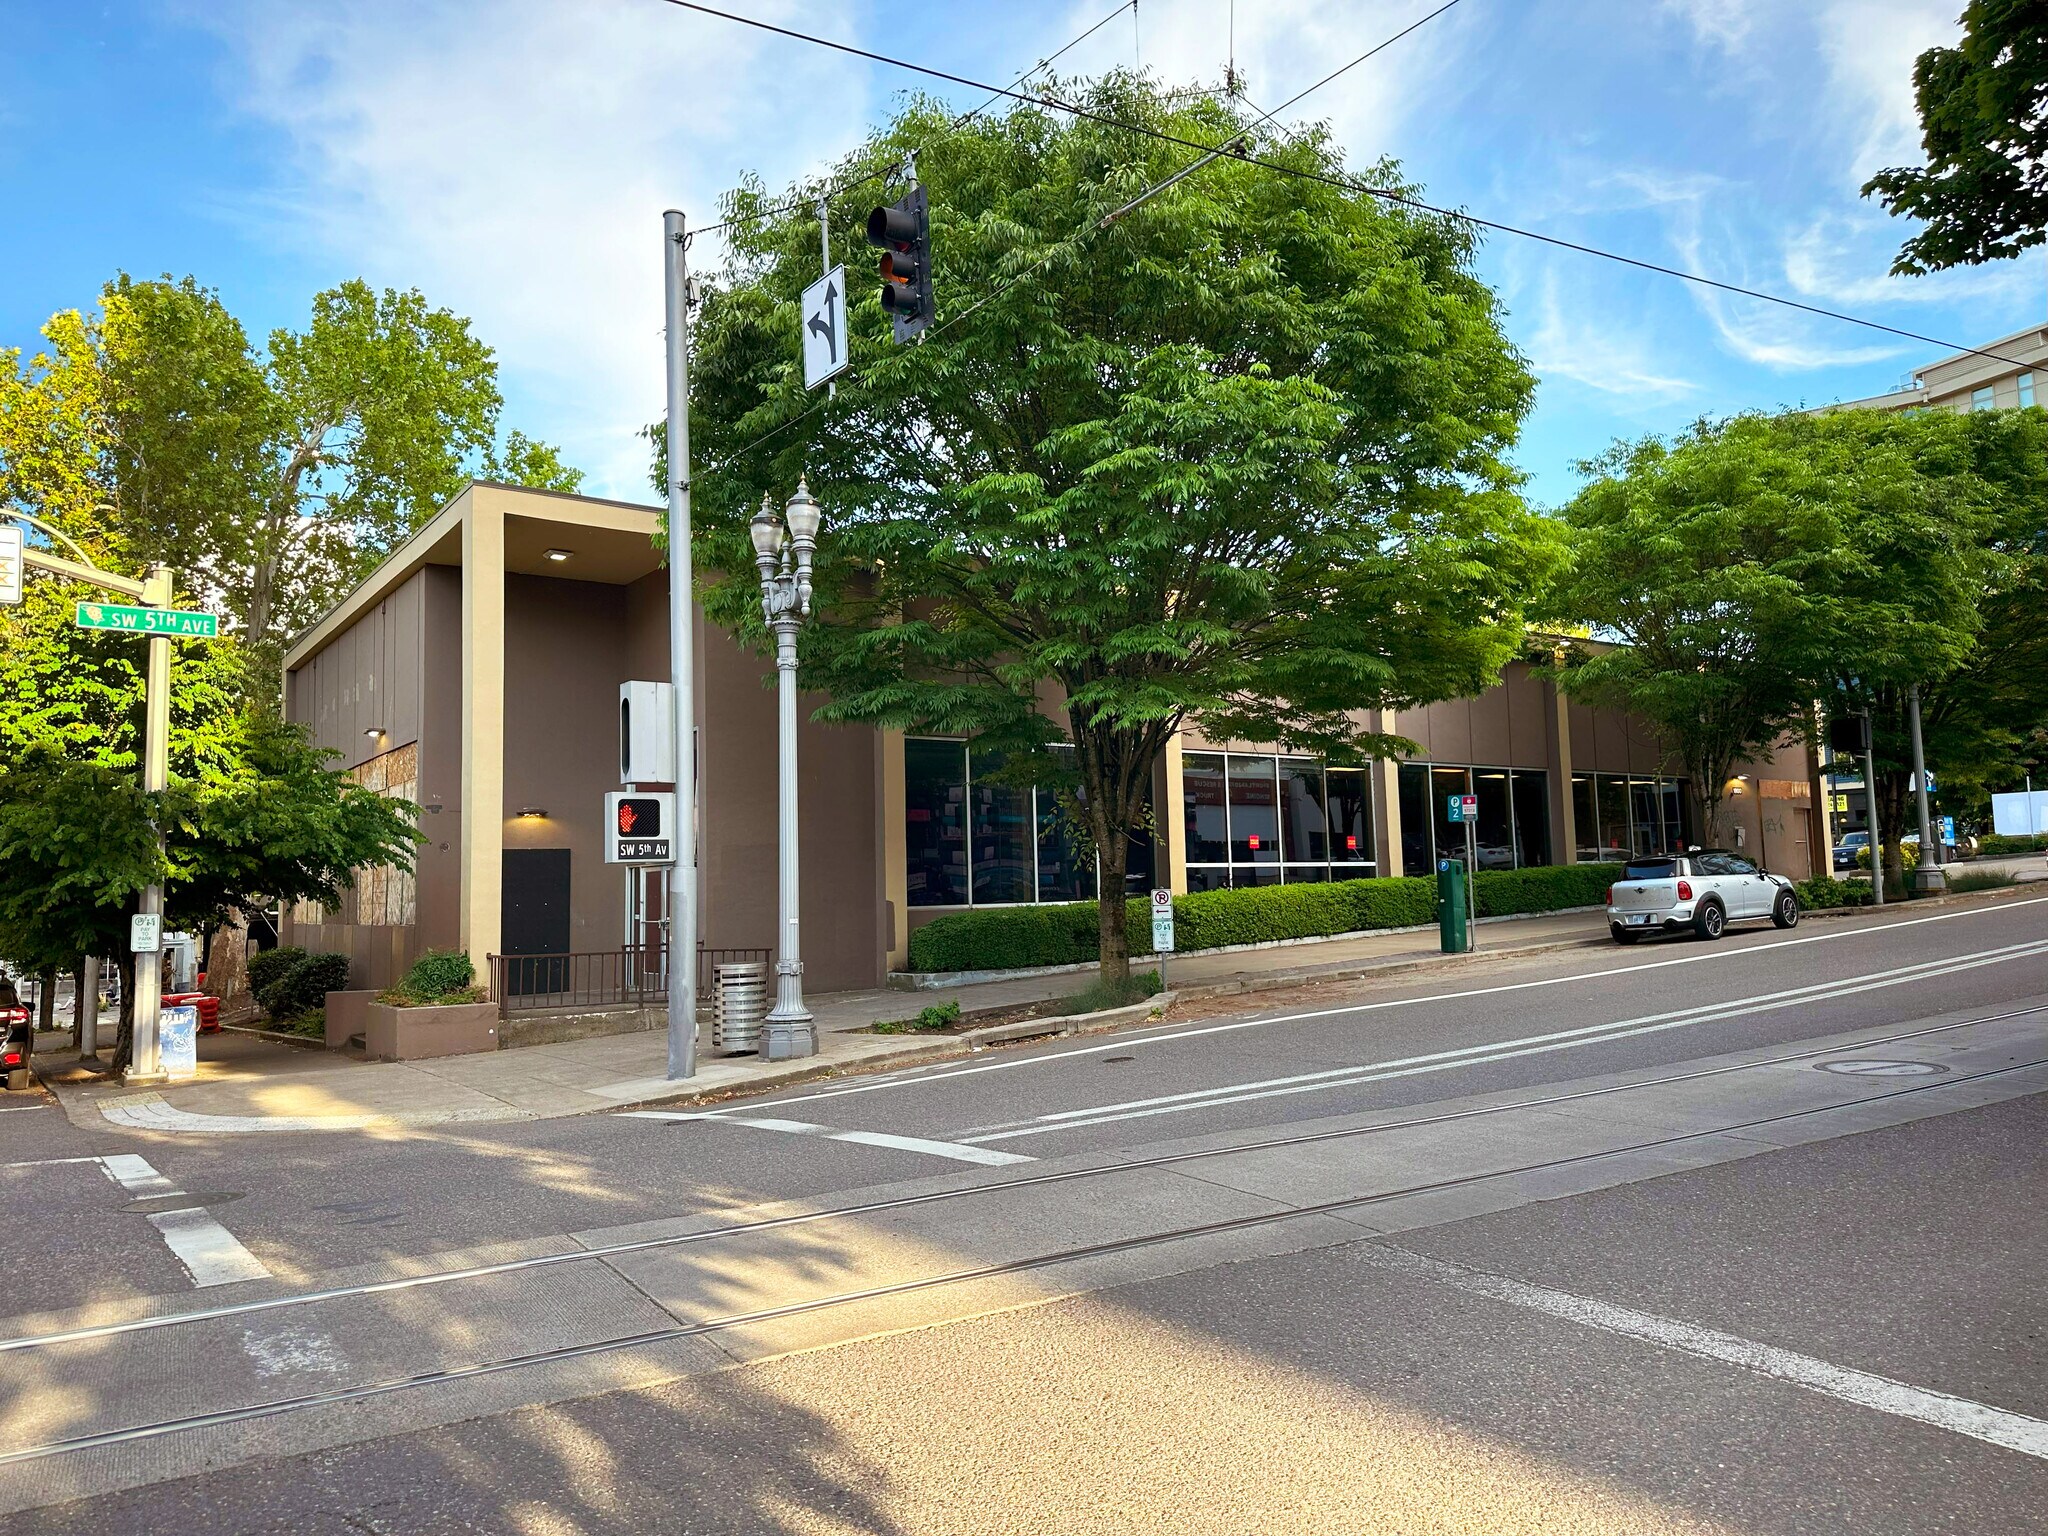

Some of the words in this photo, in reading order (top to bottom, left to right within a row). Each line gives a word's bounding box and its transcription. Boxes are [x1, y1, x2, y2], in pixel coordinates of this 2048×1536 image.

[111, 612, 138, 628] SW
[145, 611, 177, 630] 5TH
[181, 619, 212, 635] AVE
[1452, 808, 1459, 818] 2
[620, 844, 635, 856] SW
[638, 843, 652, 856] 5th
[655, 843, 667, 855] Av
